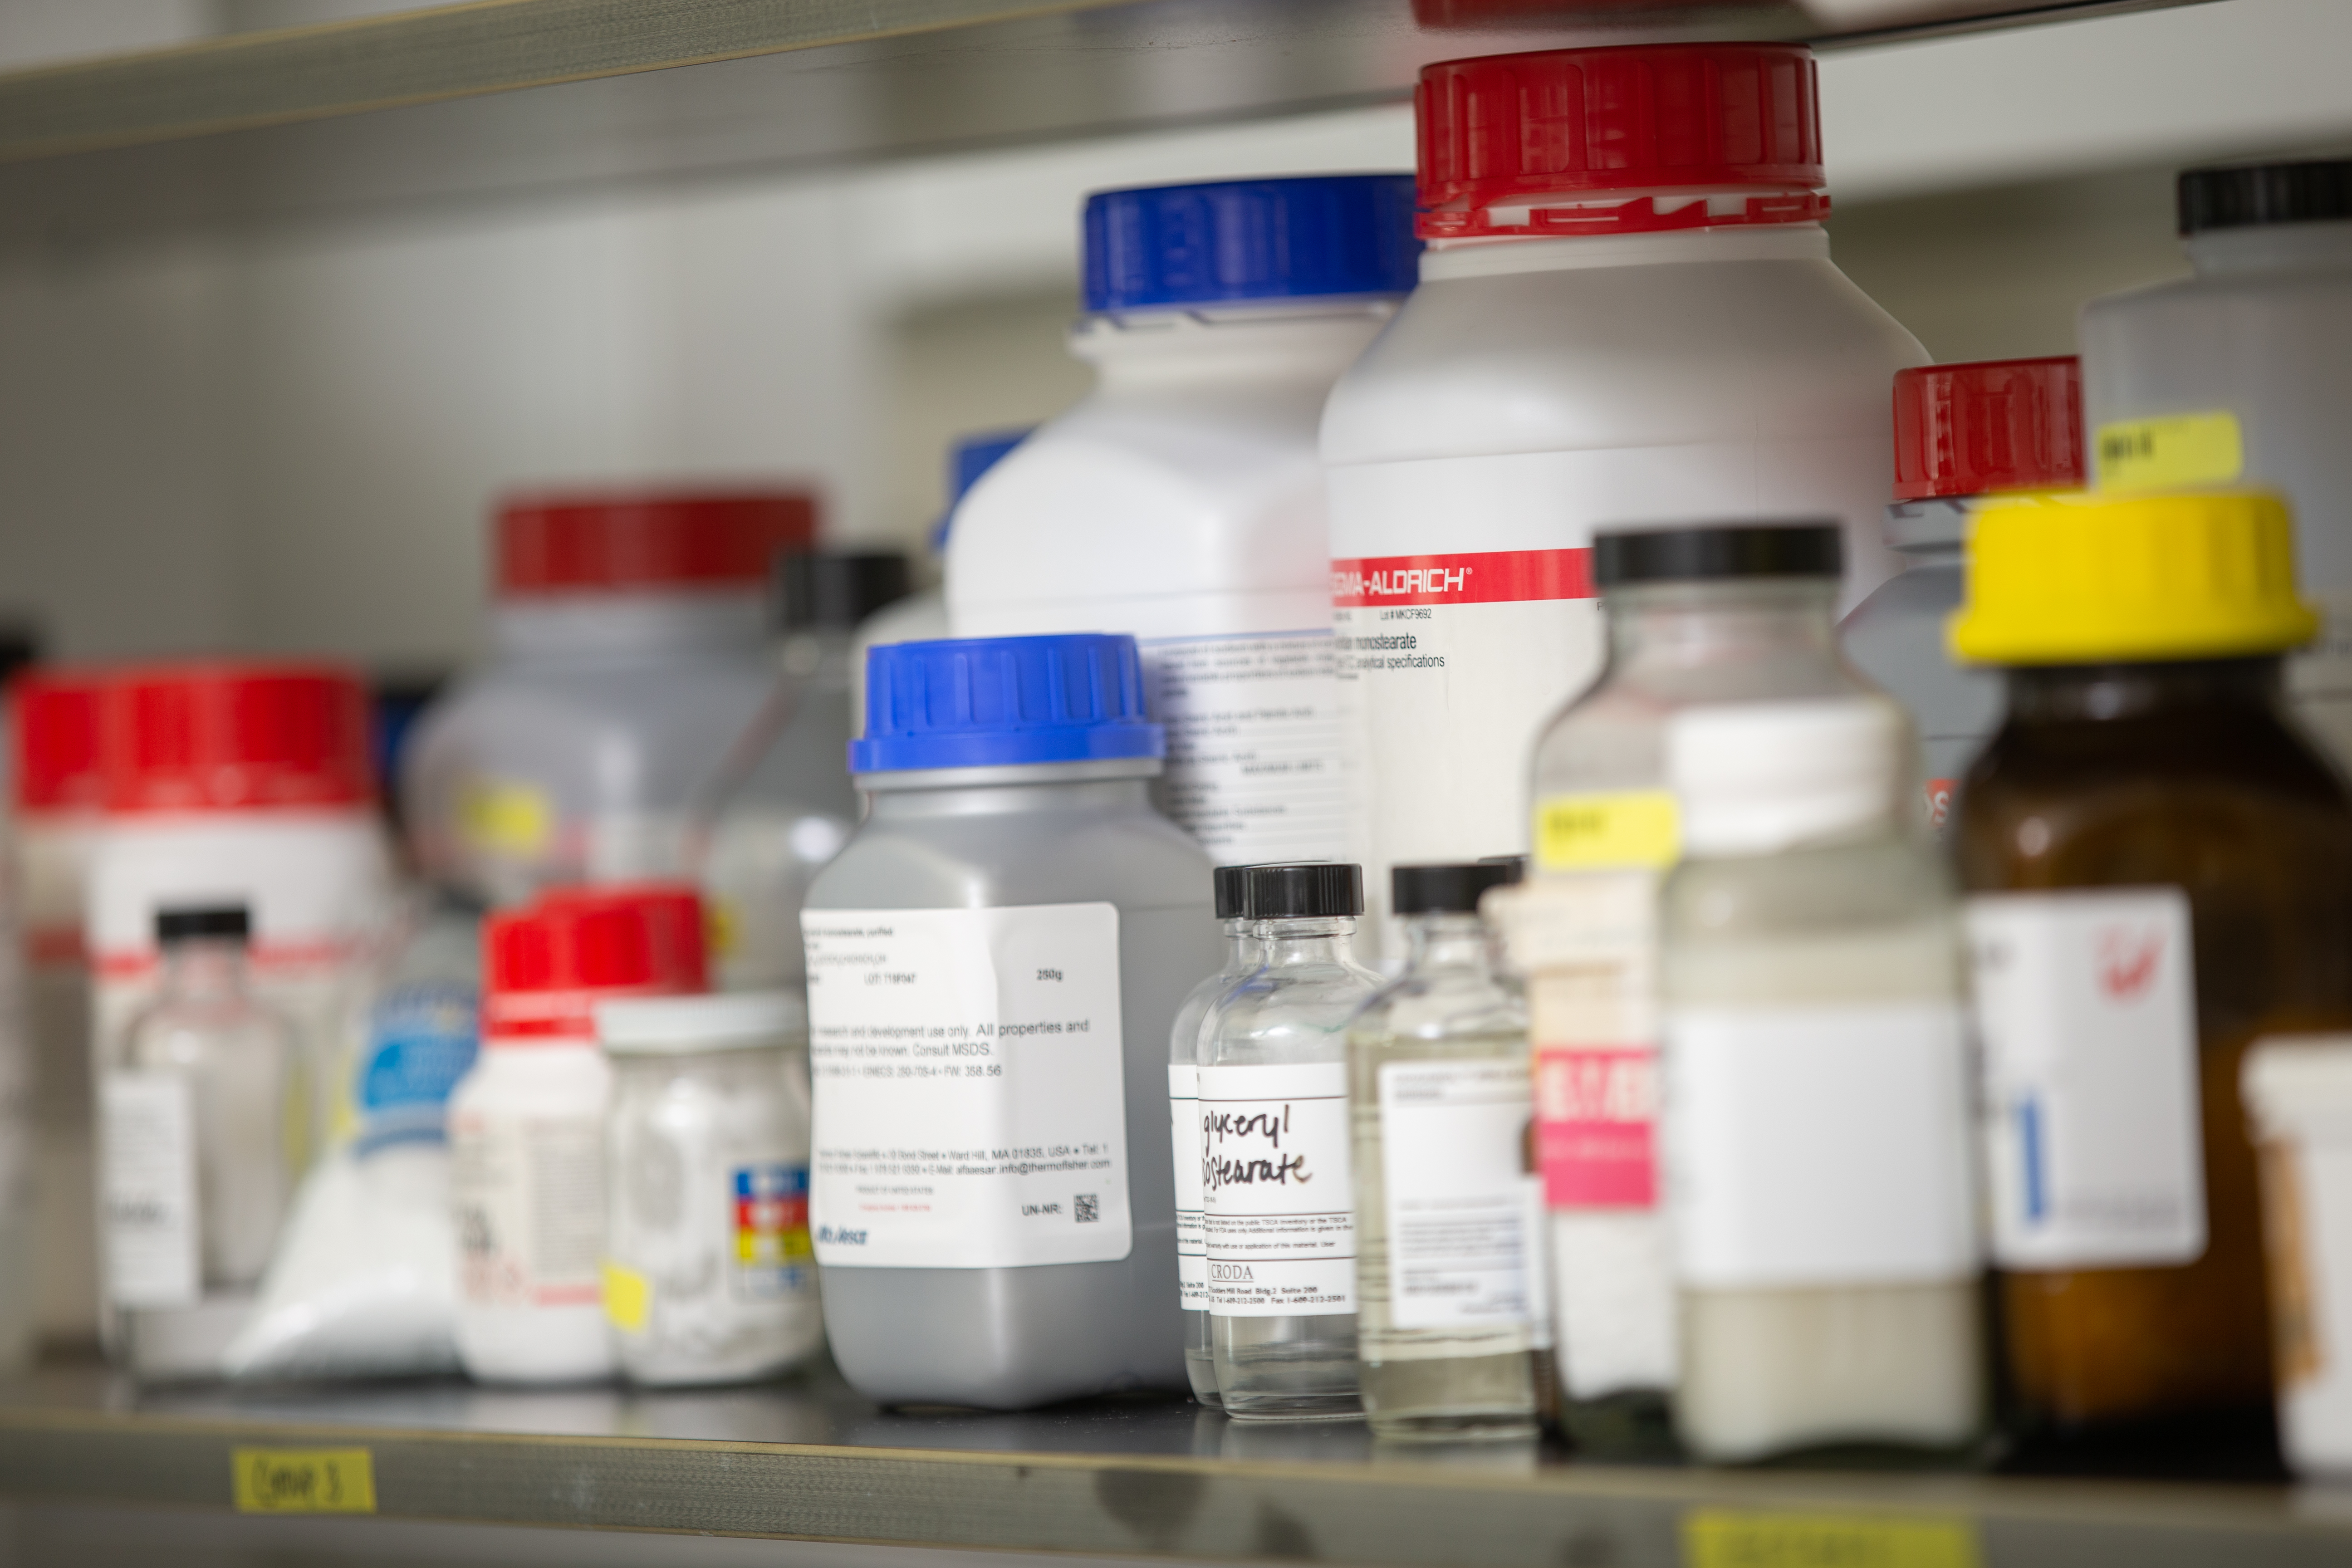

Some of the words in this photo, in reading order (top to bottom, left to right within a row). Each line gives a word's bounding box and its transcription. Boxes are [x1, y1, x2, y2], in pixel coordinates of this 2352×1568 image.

[1387, 653, 1445, 671] specifications
[1036, 969, 1063, 983] 250g
[867, 1024, 924, 1040] development
[927, 1027, 945, 1038] use
[976, 1023, 995, 1037] All
[998, 1020, 1062, 1038] properties
[1066, 1018, 1090, 1033] and
[912, 1043, 949, 1057] Consult
[952, 1043, 995, 1056] MSDS.
[965, 1064, 1003, 1077] 358.56
[1204, 1103, 1289, 1157] glyceryl
[947, 1149, 969, 1161] Ward
[971, 1149, 988, 1161] Hill,
[991, 1149, 1009, 1161] MA
[1048, 1145, 1069, 1157] USA
[1202, 1153, 1313, 1192] sostearate
[1021, 1203, 1063, 1216] UN-NR:
[1211, 1264, 1254, 1279] CRODA
[1287, 1294, 1346, 1304] 1-609-212-2501
